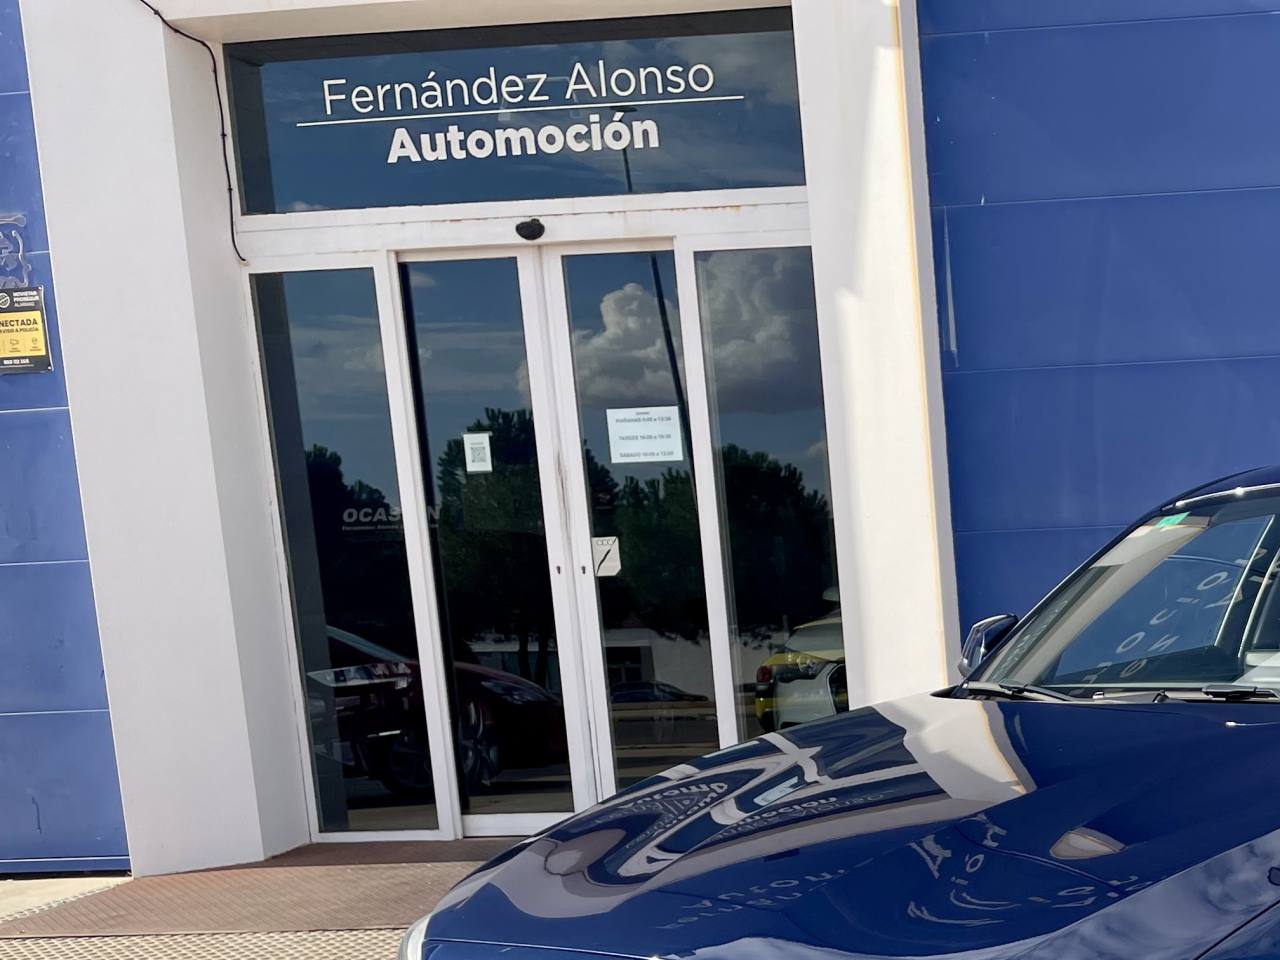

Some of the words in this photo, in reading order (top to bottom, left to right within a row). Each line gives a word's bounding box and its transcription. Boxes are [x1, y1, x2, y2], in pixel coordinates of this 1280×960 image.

[322, 66, 550, 117] Fernández
[564, 59, 715, 99] Alonso
[387, 111, 660, 164] Automoción
[342, 505, 441, 523] OCASN
